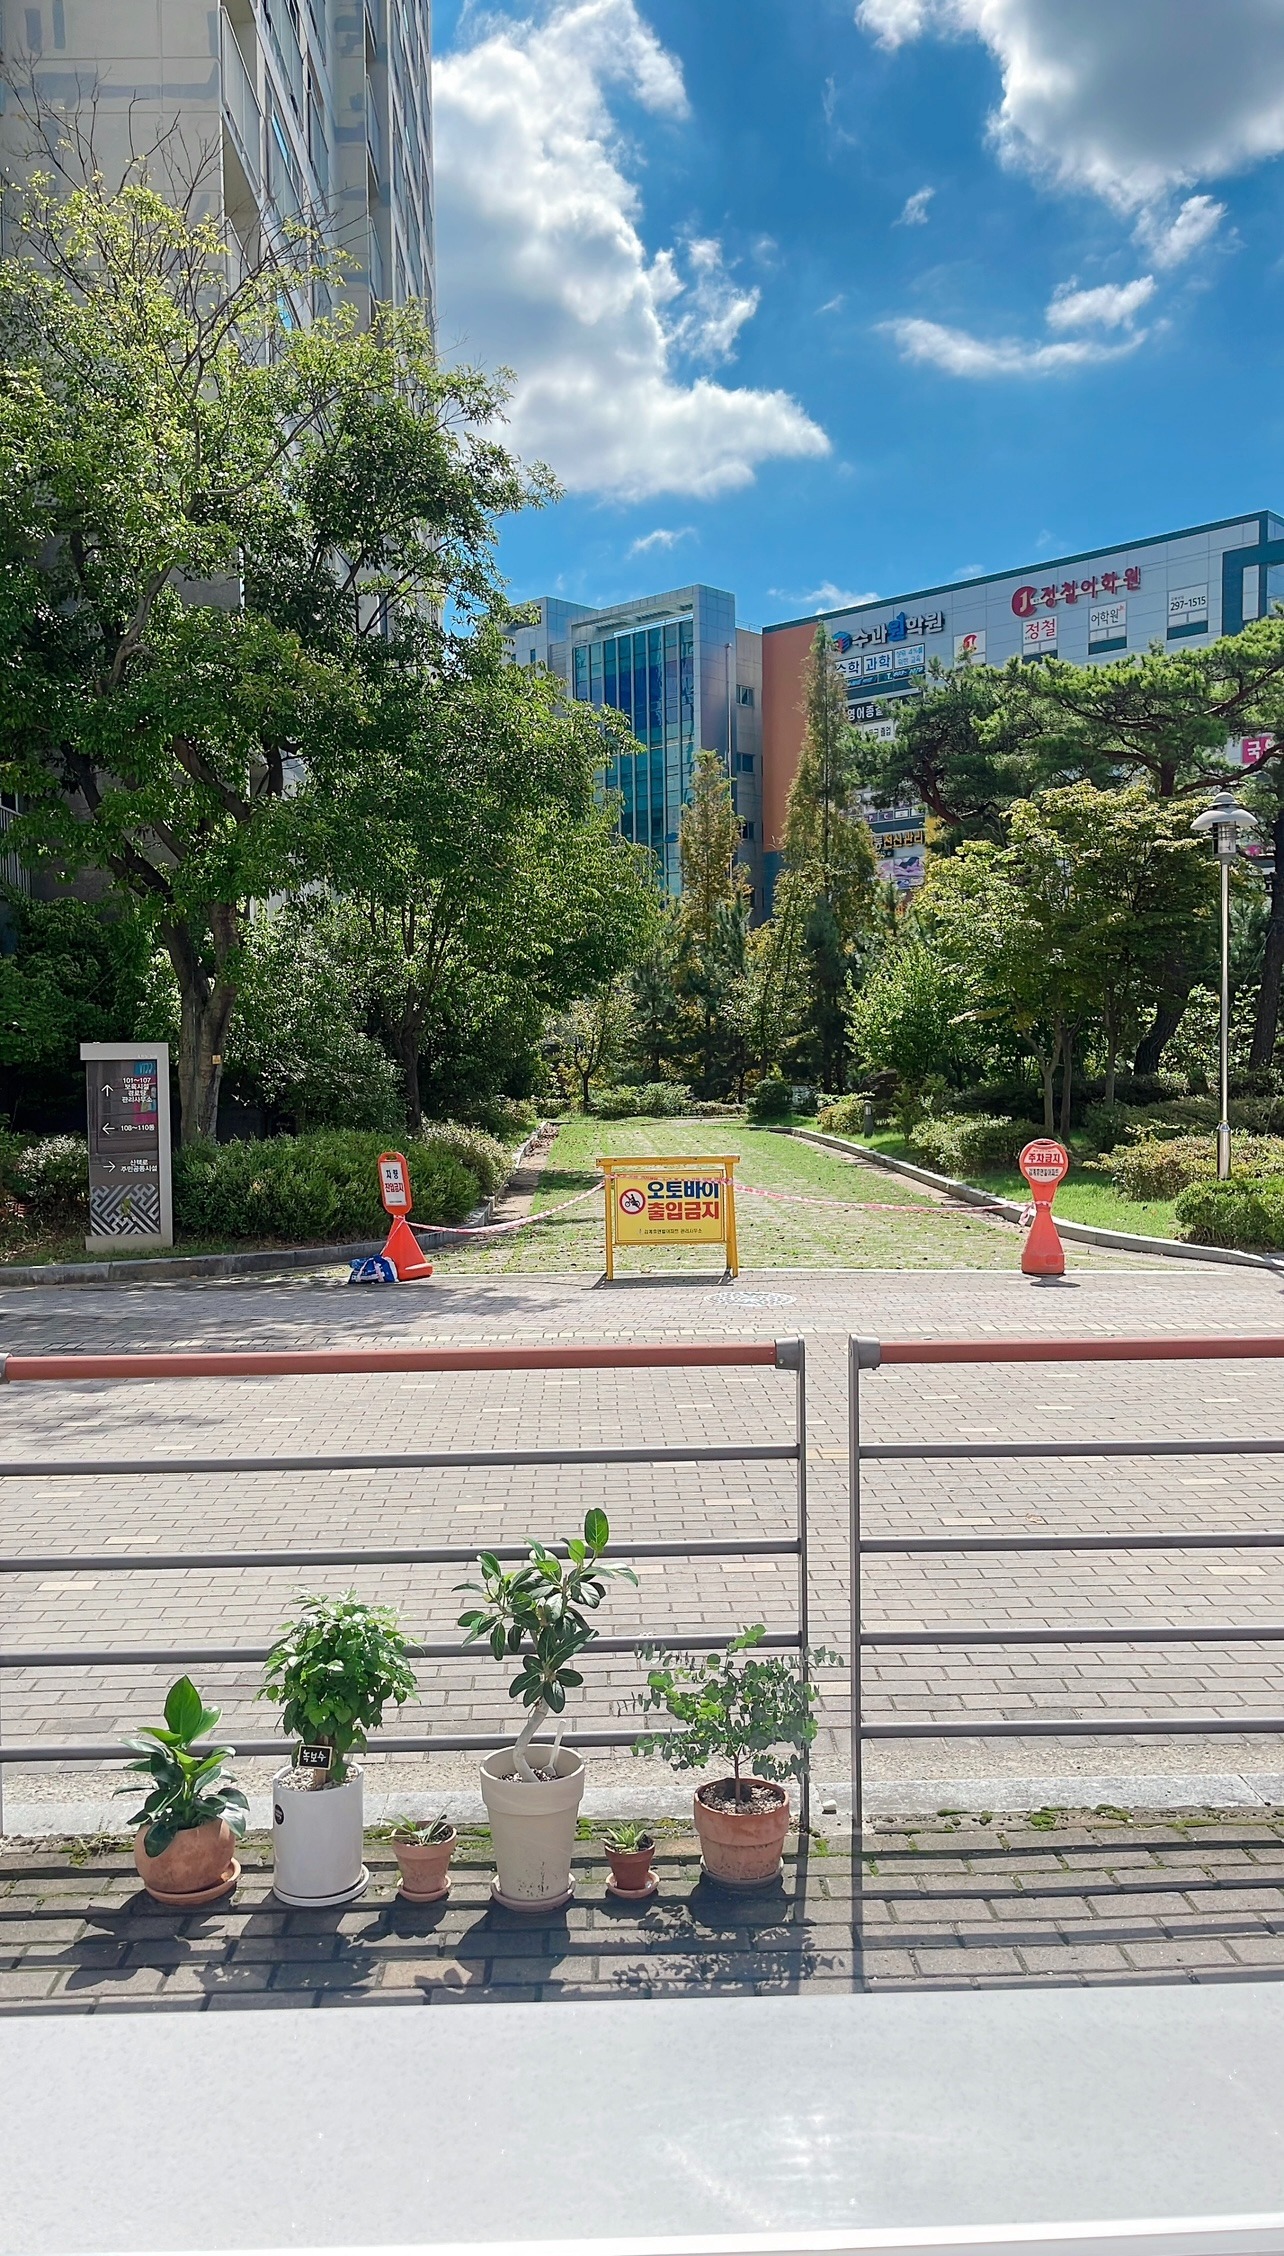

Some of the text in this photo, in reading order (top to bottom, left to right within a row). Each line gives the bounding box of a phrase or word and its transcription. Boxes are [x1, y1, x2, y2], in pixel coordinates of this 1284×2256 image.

[1040, 566, 1141, 608] 정철어학원
[1170, 596, 1206, 611] 297-1515
[1091, 609, 1119, 626] 어학원
[852, 611, 944, 648] 수과원학원
[1025, 618, 1056, 640] 정철
[866, 655, 890, 671] 과학
[1029, 1154, 1060, 1163] 주차금지
[647, 1181, 719, 1199] 오토바이
[647, 1202, 719, 1221] 출입금지
[303, 1750, 326, 1762] 녹보수
